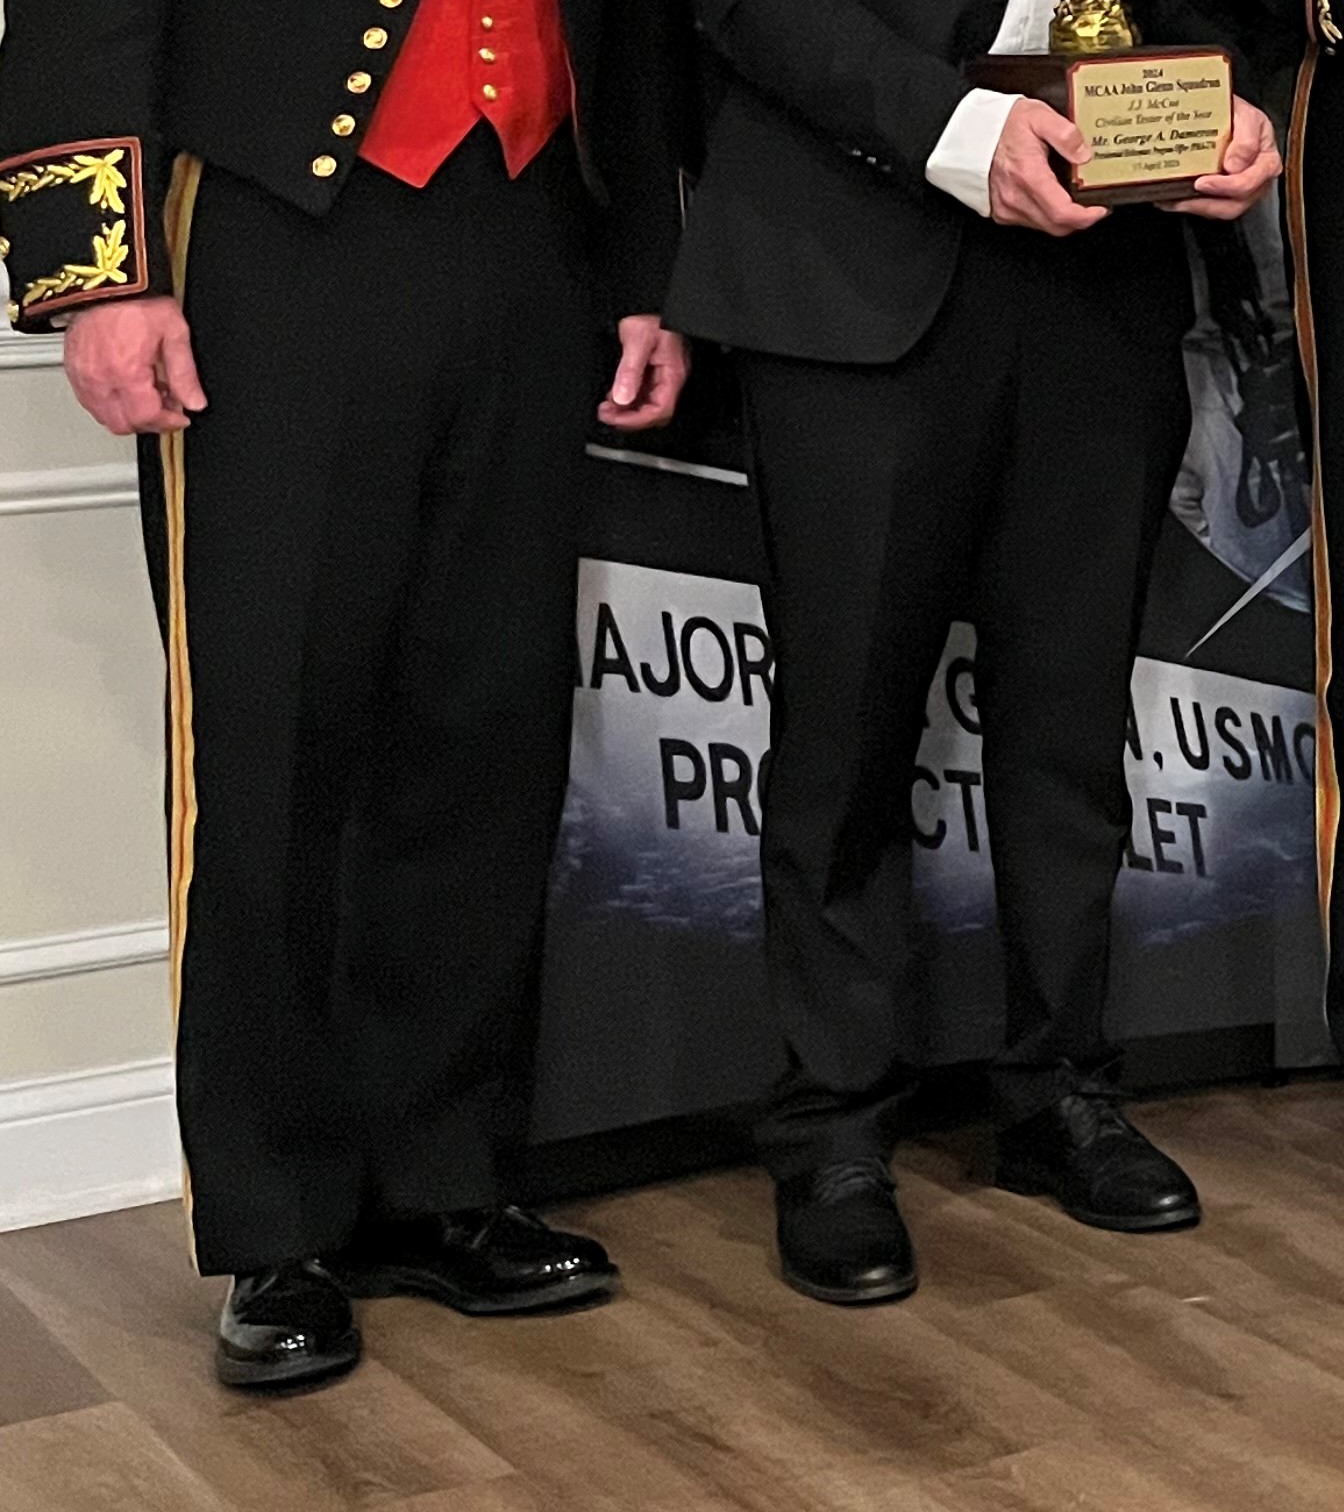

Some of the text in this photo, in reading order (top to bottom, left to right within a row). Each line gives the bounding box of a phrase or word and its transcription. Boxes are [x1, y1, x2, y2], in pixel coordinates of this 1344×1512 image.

[1084, 78, 1221, 97] MCAA John Glenn Squadron
[1165, 112, 1174, 124] of
[1176, 112, 1191, 121] the
[1113, 133, 1152, 146] George
